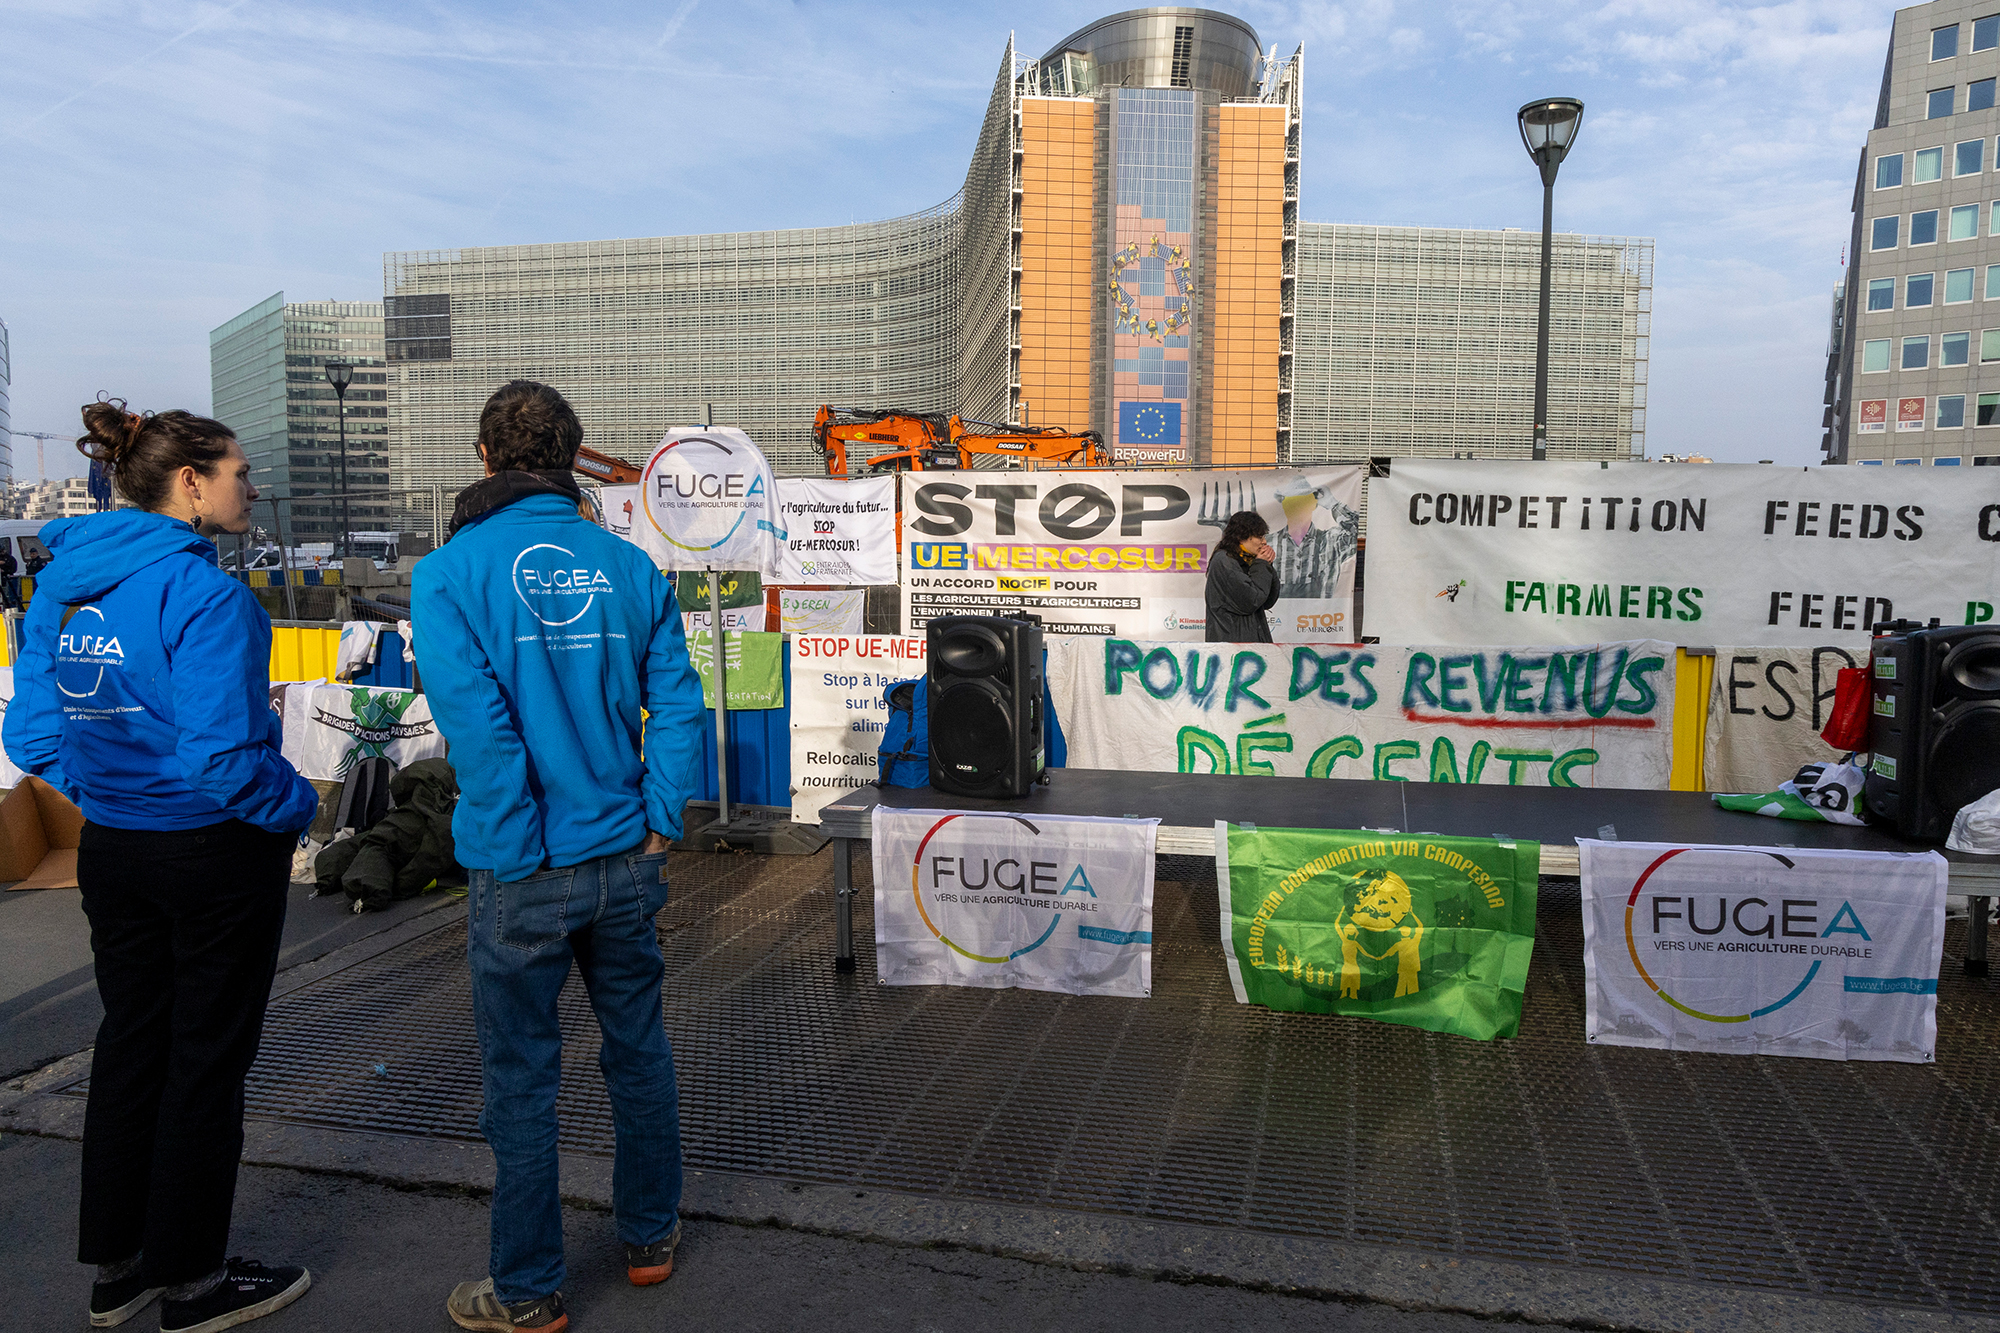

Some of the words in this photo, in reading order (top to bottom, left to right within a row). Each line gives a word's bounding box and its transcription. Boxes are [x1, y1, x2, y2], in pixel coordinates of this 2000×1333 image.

[869, 433, 899, 443] LIEBHERR
[579, 458, 611, 474] DOOSAN
[657, 474, 766, 499] FUGEA
[658, 501, 675, 509] VERS
[787, 502, 841, 516] l'agriculture
[842, 502, 854, 513] du
[814, 520, 836, 532] STOP
[1764, 500, 1925, 541] FEEDS
[915, 545, 1202, 571] UE-MERCOSUR
[522, 569, 610, 588] FUGEA
[911, 578, 929, 588] UN
[933, 579, 994, 589] ACCORD
[1000, 579, 1047, 589] NOCIF
[1054, 581, 1098, 591] POUR
[912, 594, 933, 604] LES
[935, 595, 1022, 605] AGRICULTEURS
[1024, 597, 1038, 606] ET
[1040, 598, 1139, 608] AGRICULTRICES
[1504, 580, 1704, 621] FARMERS
[1296, 612, 1345, 629] STOP
[1768, 591, 1893, 632] FEED
[1053, 624, 1114, 634] HUMAINS.
[59, 634, 125, 658] FUGEA
[798, 637, 850, 659] STOP
[823, 673, 858, 690] Stop
[863, 673, 872, 688] à
[876, 673, 887, 688] la
[1104, 638, 1271, 713] POUR
[1289, 645, 1376, 711] DES
[1402, 647, 1665, 718] REVENUS
[845, 697, 869, 710] sur
[873, 696, 888, 710] le
[321, 713, 356, 731] BRIGADES
[354, 727, 391, 742] D'ACTIONS
[806, 751, 877, 767] Relocalis
[802, 774, 878, 788] nourritur
[932, 856, 1098, 898] FUGEA
[934, 893, 958, 903] VERS
[960, 895, 980, 904] UNE
[982, 896, 1050, 909] AGRICULTURE
[1053, 901, 1098, 912] DURABLE
[1247, 891, 1285, 967] EUROPEAN
[1280, 841, 1386, 895] COORDINATION
[1390, 841, 1418, 857] VIA
[1424, 844, 1506, 909] CAMPESINA
[1652, 897, 1872, 941] FUGEA
[1654, 940, 1686, 952] VERS
[1688, 941, 1714, 952] UNE
[1717, 942, 1807, 955] AGRICULTURE
[1811, 945, 1872, 959] DURABLE
[1849, 978, 1923, 992] www.fugea.be
[513, 1306, 541, 1324] SCOTT
